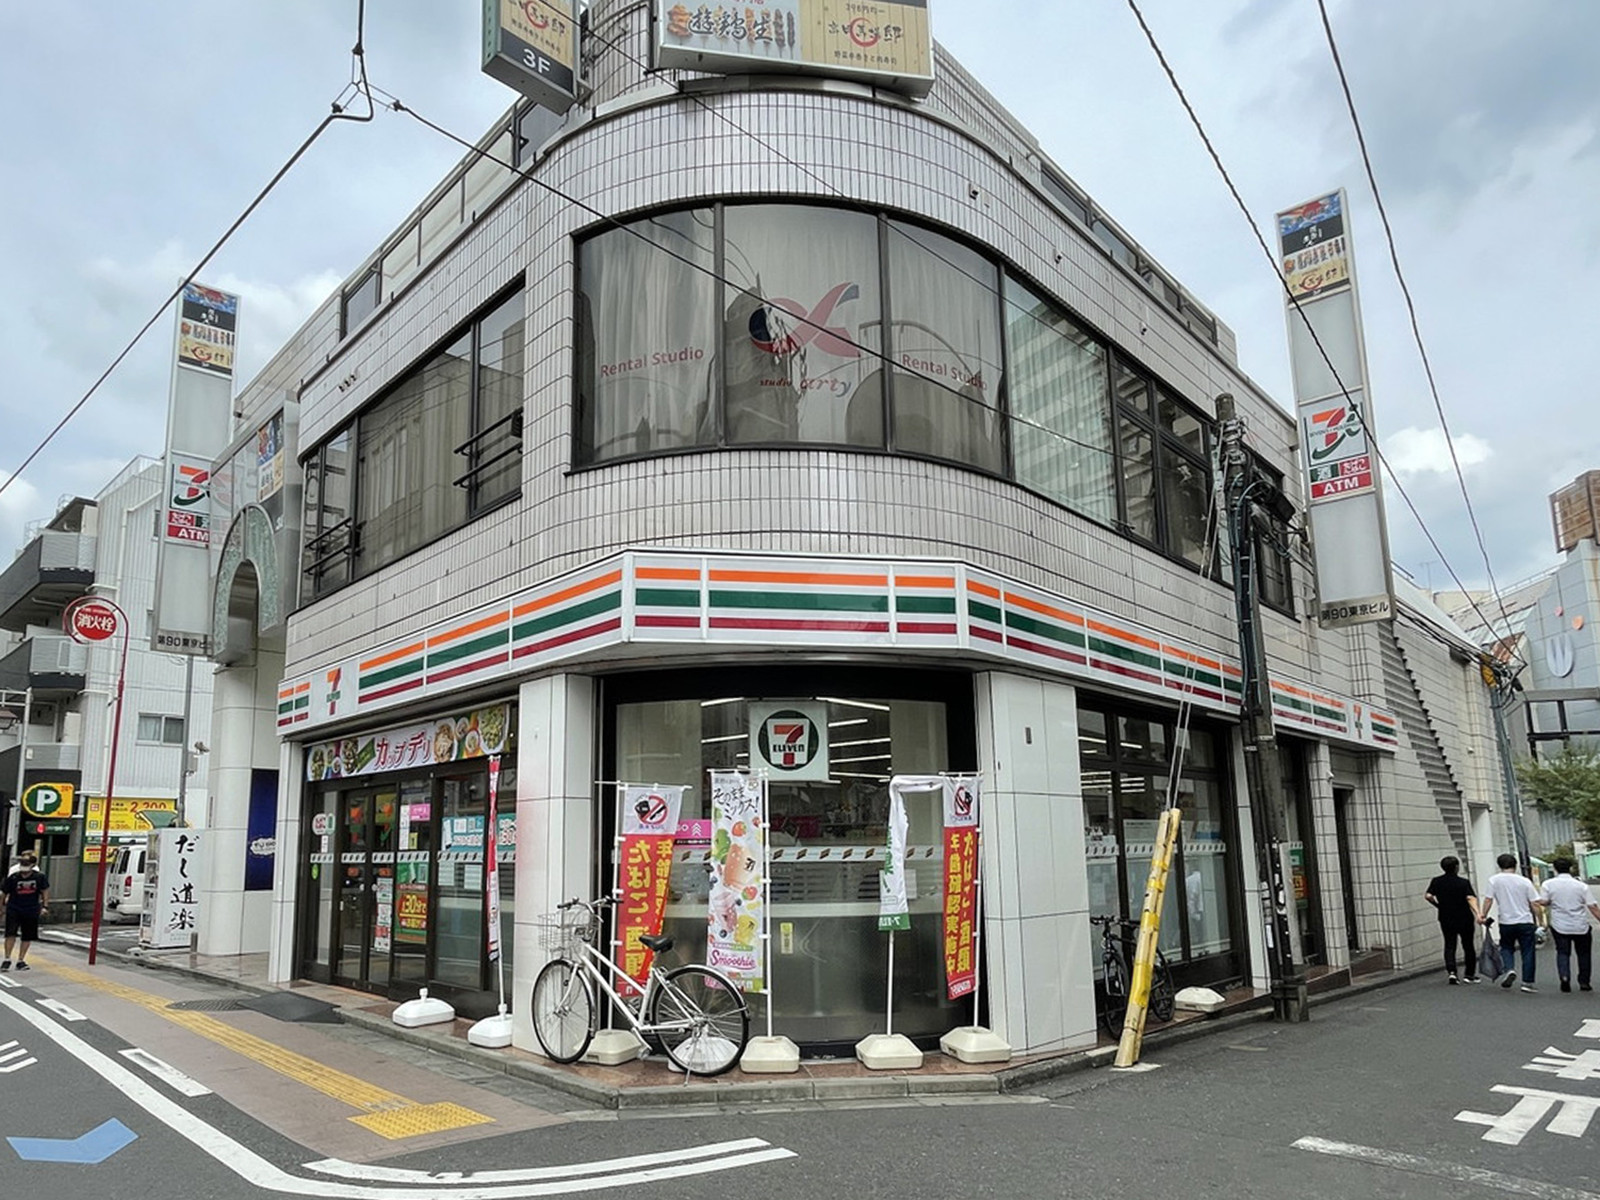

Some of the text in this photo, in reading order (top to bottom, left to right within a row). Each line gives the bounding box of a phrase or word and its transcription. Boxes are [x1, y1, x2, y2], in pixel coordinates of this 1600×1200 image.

[522, 48, 551, 73] 3F
[600, 346, 704, 379] Rental Studio
[902, 353, 988, 391] Rental Studio
[760, 376, 793, 387] studio
[1323, 476, 1360, 496] ATM
[178, 528, 209, 542] ATM
[77, 611, 115, 633] 消火栓
[1321, 602, 1388, 621] 第90東京ビル
[374, 730, 431, 769] カップデリ
[36, 789, 58, 811] P
[713, 787, 744, 805] そのまま
[169, 834, 200, 931] だし道楽
[958, 831, 973, 974] たばこ・酒類
[711, 949, 756, 969] Smoothie
